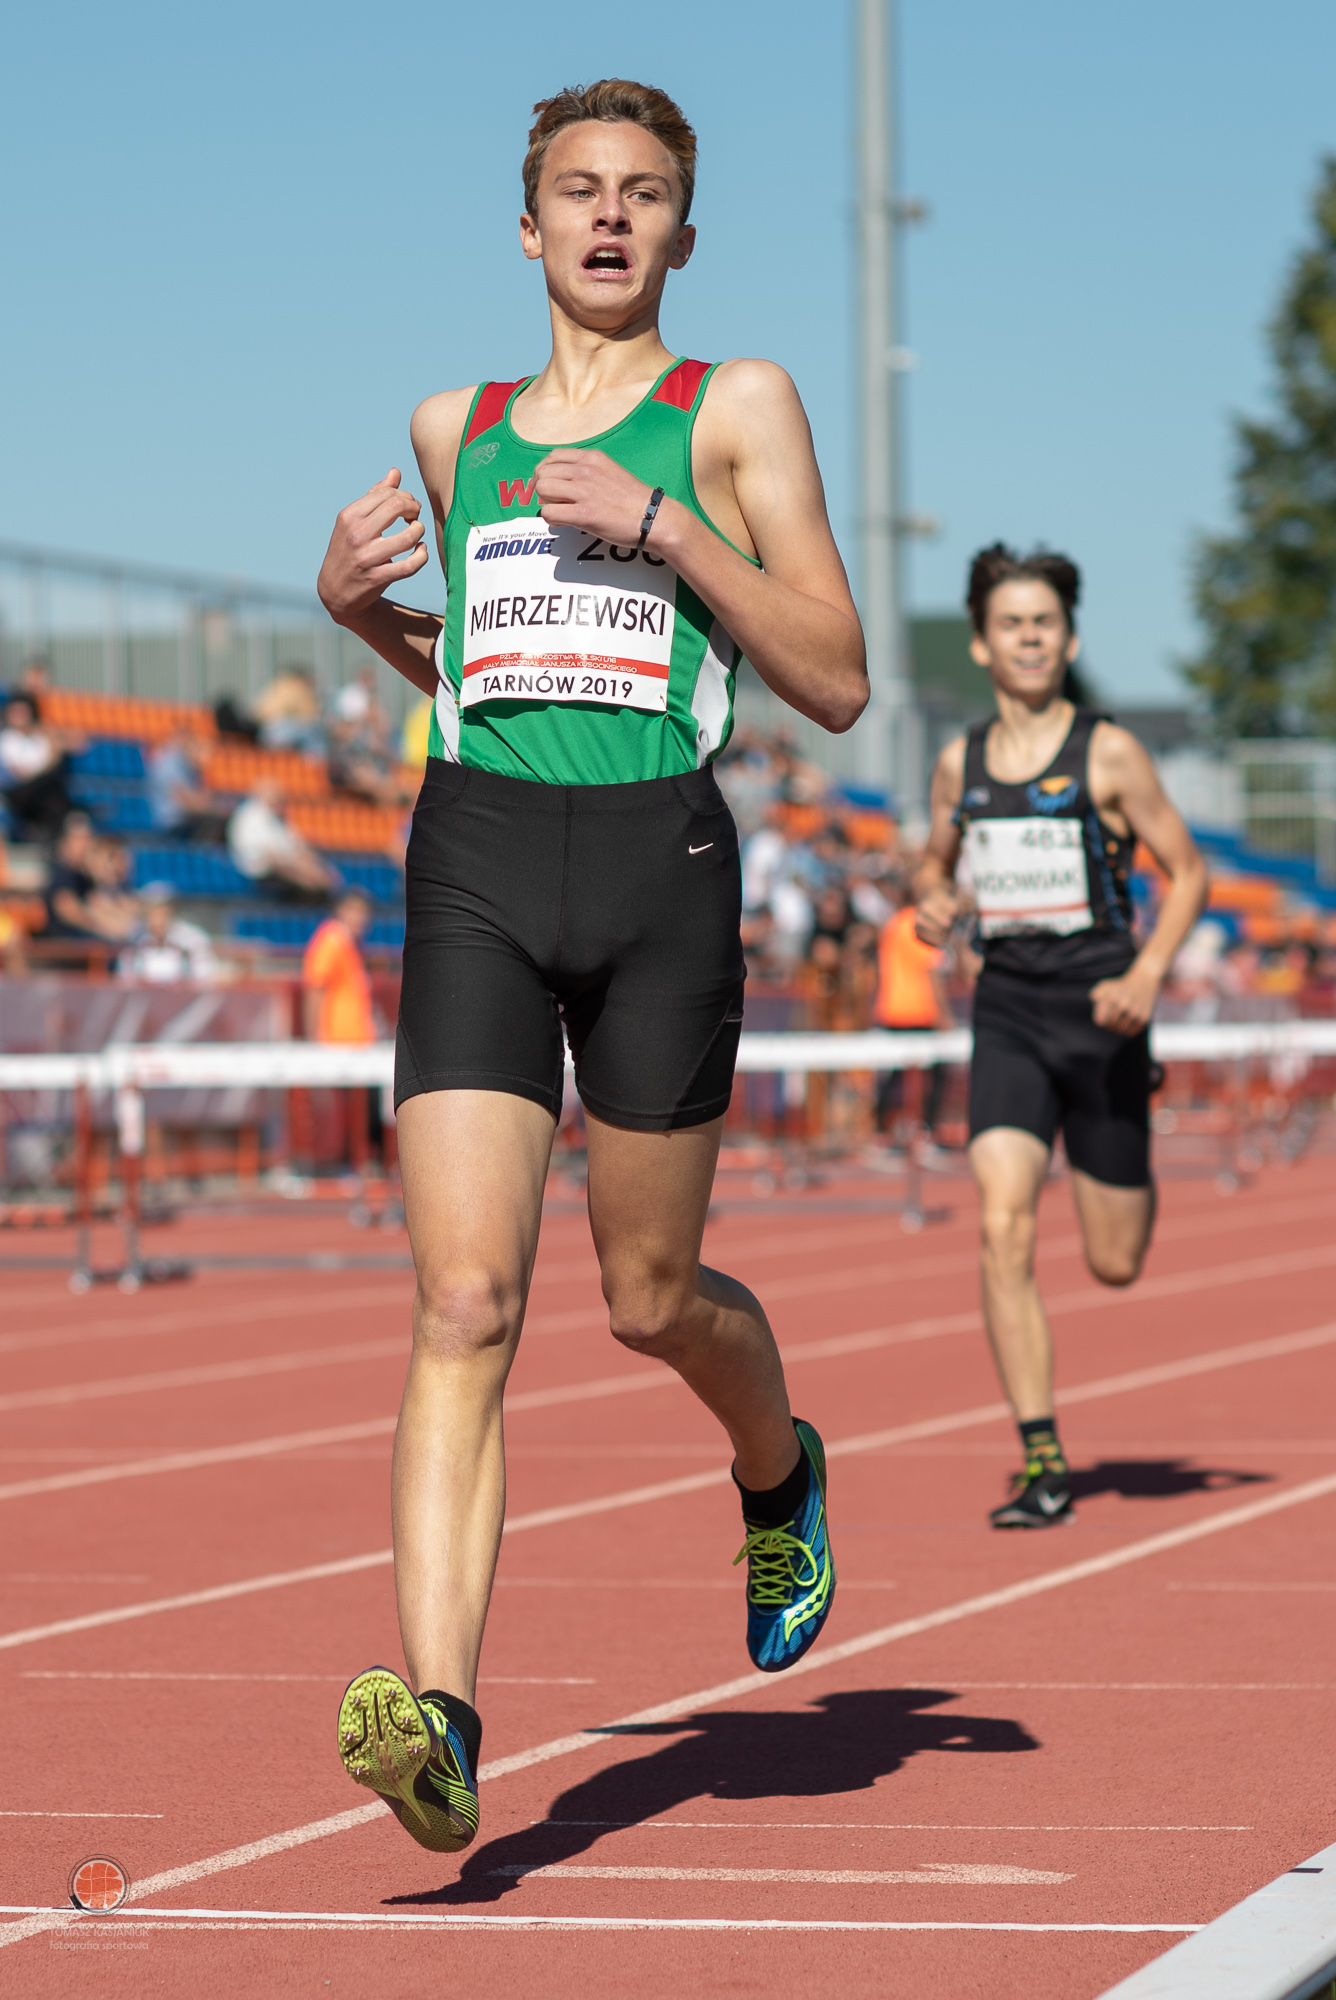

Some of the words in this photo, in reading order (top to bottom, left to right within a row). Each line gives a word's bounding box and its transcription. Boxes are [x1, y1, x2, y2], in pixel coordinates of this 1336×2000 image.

[510, 532, 525, 541] your
[525, 530, 548, 538] Move
[470, 594, 667, 637] MIERZEJEWSKI
[499, 653, 519, 661] PZLA
[574, 653, 602, 663] POLSKI
[602, 655, 617, 664] U16
[540, 659, 576, 669] JANUSZA
[482, 670, 576, 695] TARNÓW
[580, 676, 634, 699] 2019
